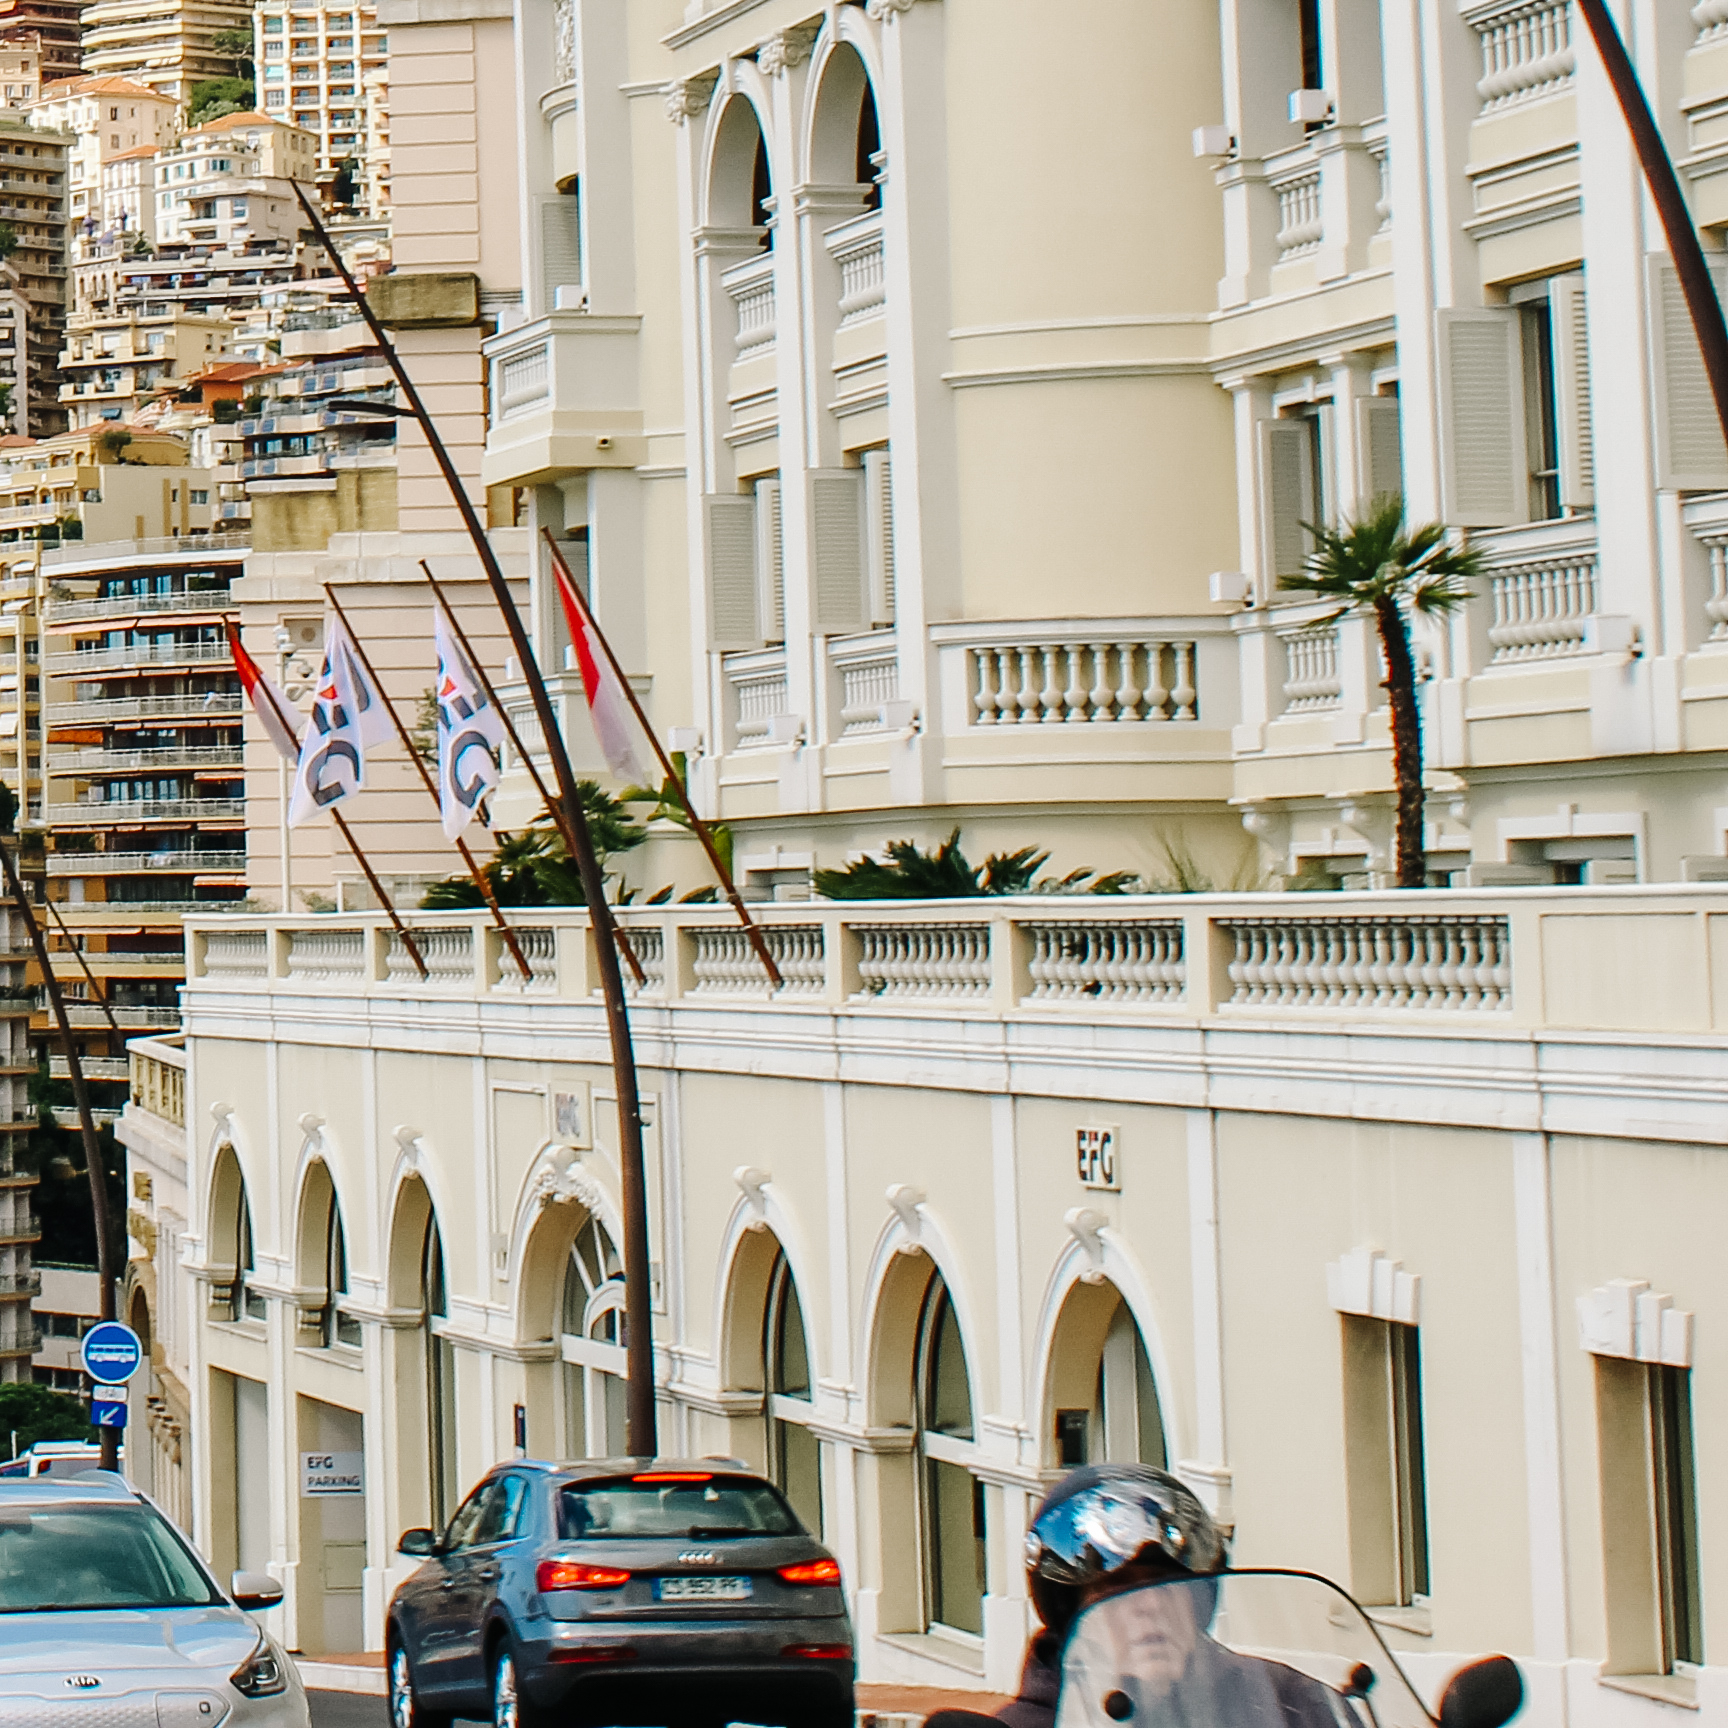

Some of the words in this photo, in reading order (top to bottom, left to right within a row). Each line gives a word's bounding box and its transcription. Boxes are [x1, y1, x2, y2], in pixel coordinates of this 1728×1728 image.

[1076, 1129, 1113, 1184] EFG
[307, 1456, 333, 1469] EFG
[308, 1475, 360, 1486] PARKING
[72, 1676, 97, 1686] KIA
